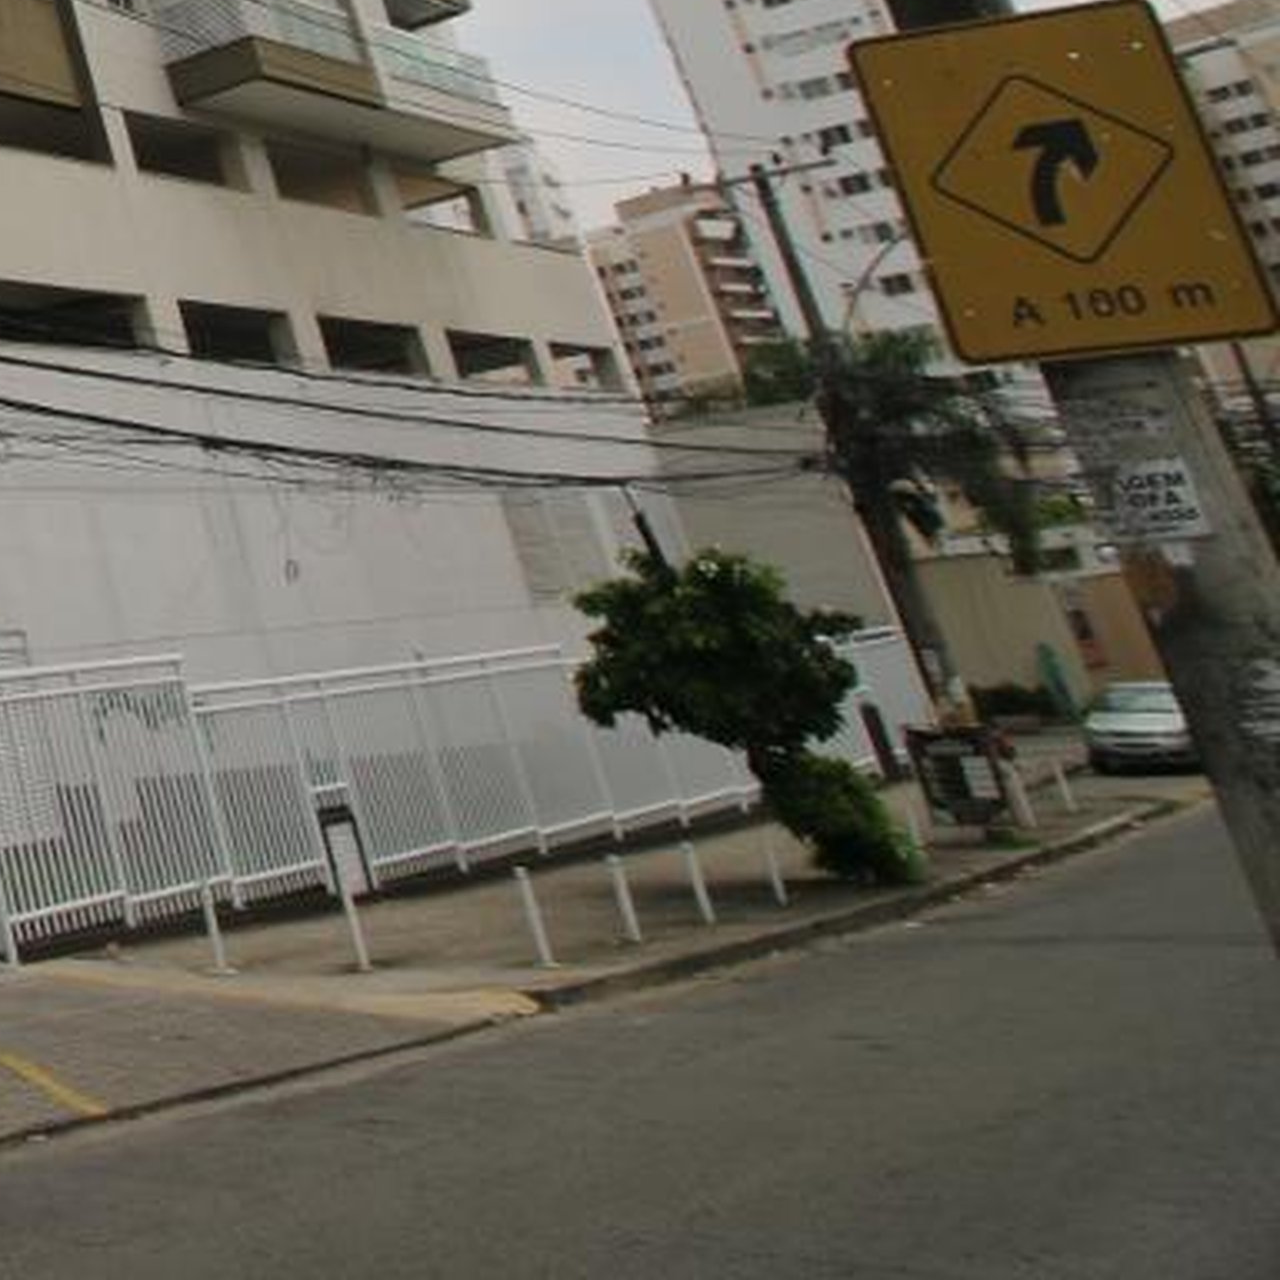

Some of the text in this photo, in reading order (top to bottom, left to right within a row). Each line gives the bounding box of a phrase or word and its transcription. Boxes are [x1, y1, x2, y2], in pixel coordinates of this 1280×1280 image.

[1012, 281, 1216, 329] A 100 m
